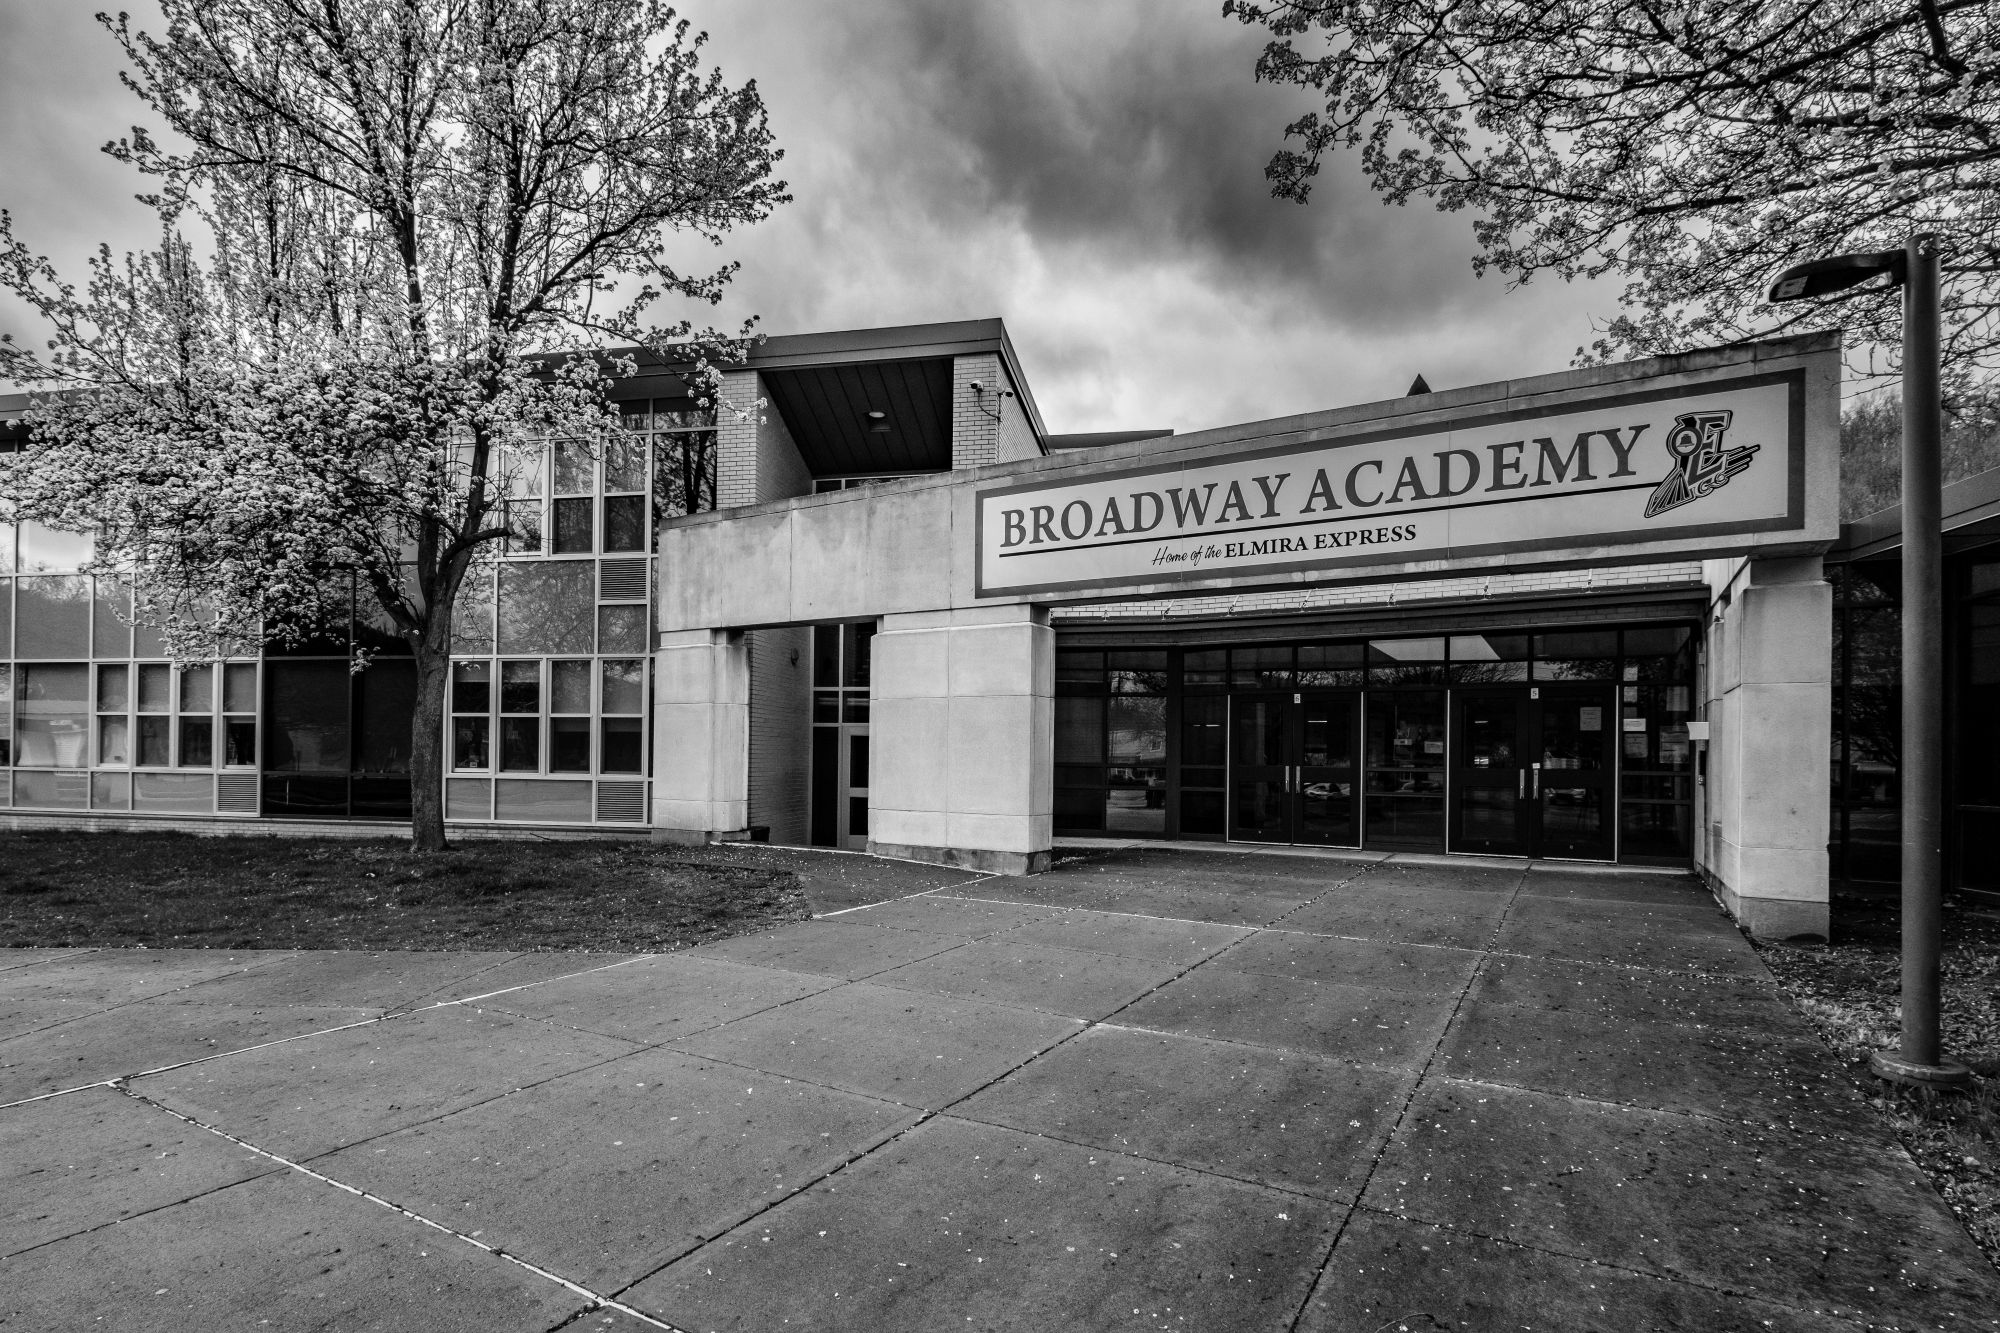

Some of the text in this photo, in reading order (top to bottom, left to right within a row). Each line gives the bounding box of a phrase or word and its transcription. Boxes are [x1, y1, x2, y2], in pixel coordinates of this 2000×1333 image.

[1000, 423, 1650, 547] BROADWAY ACADEMY
[1152, 524, 1417, 566] Home of the ELMIRA EXPRESS
